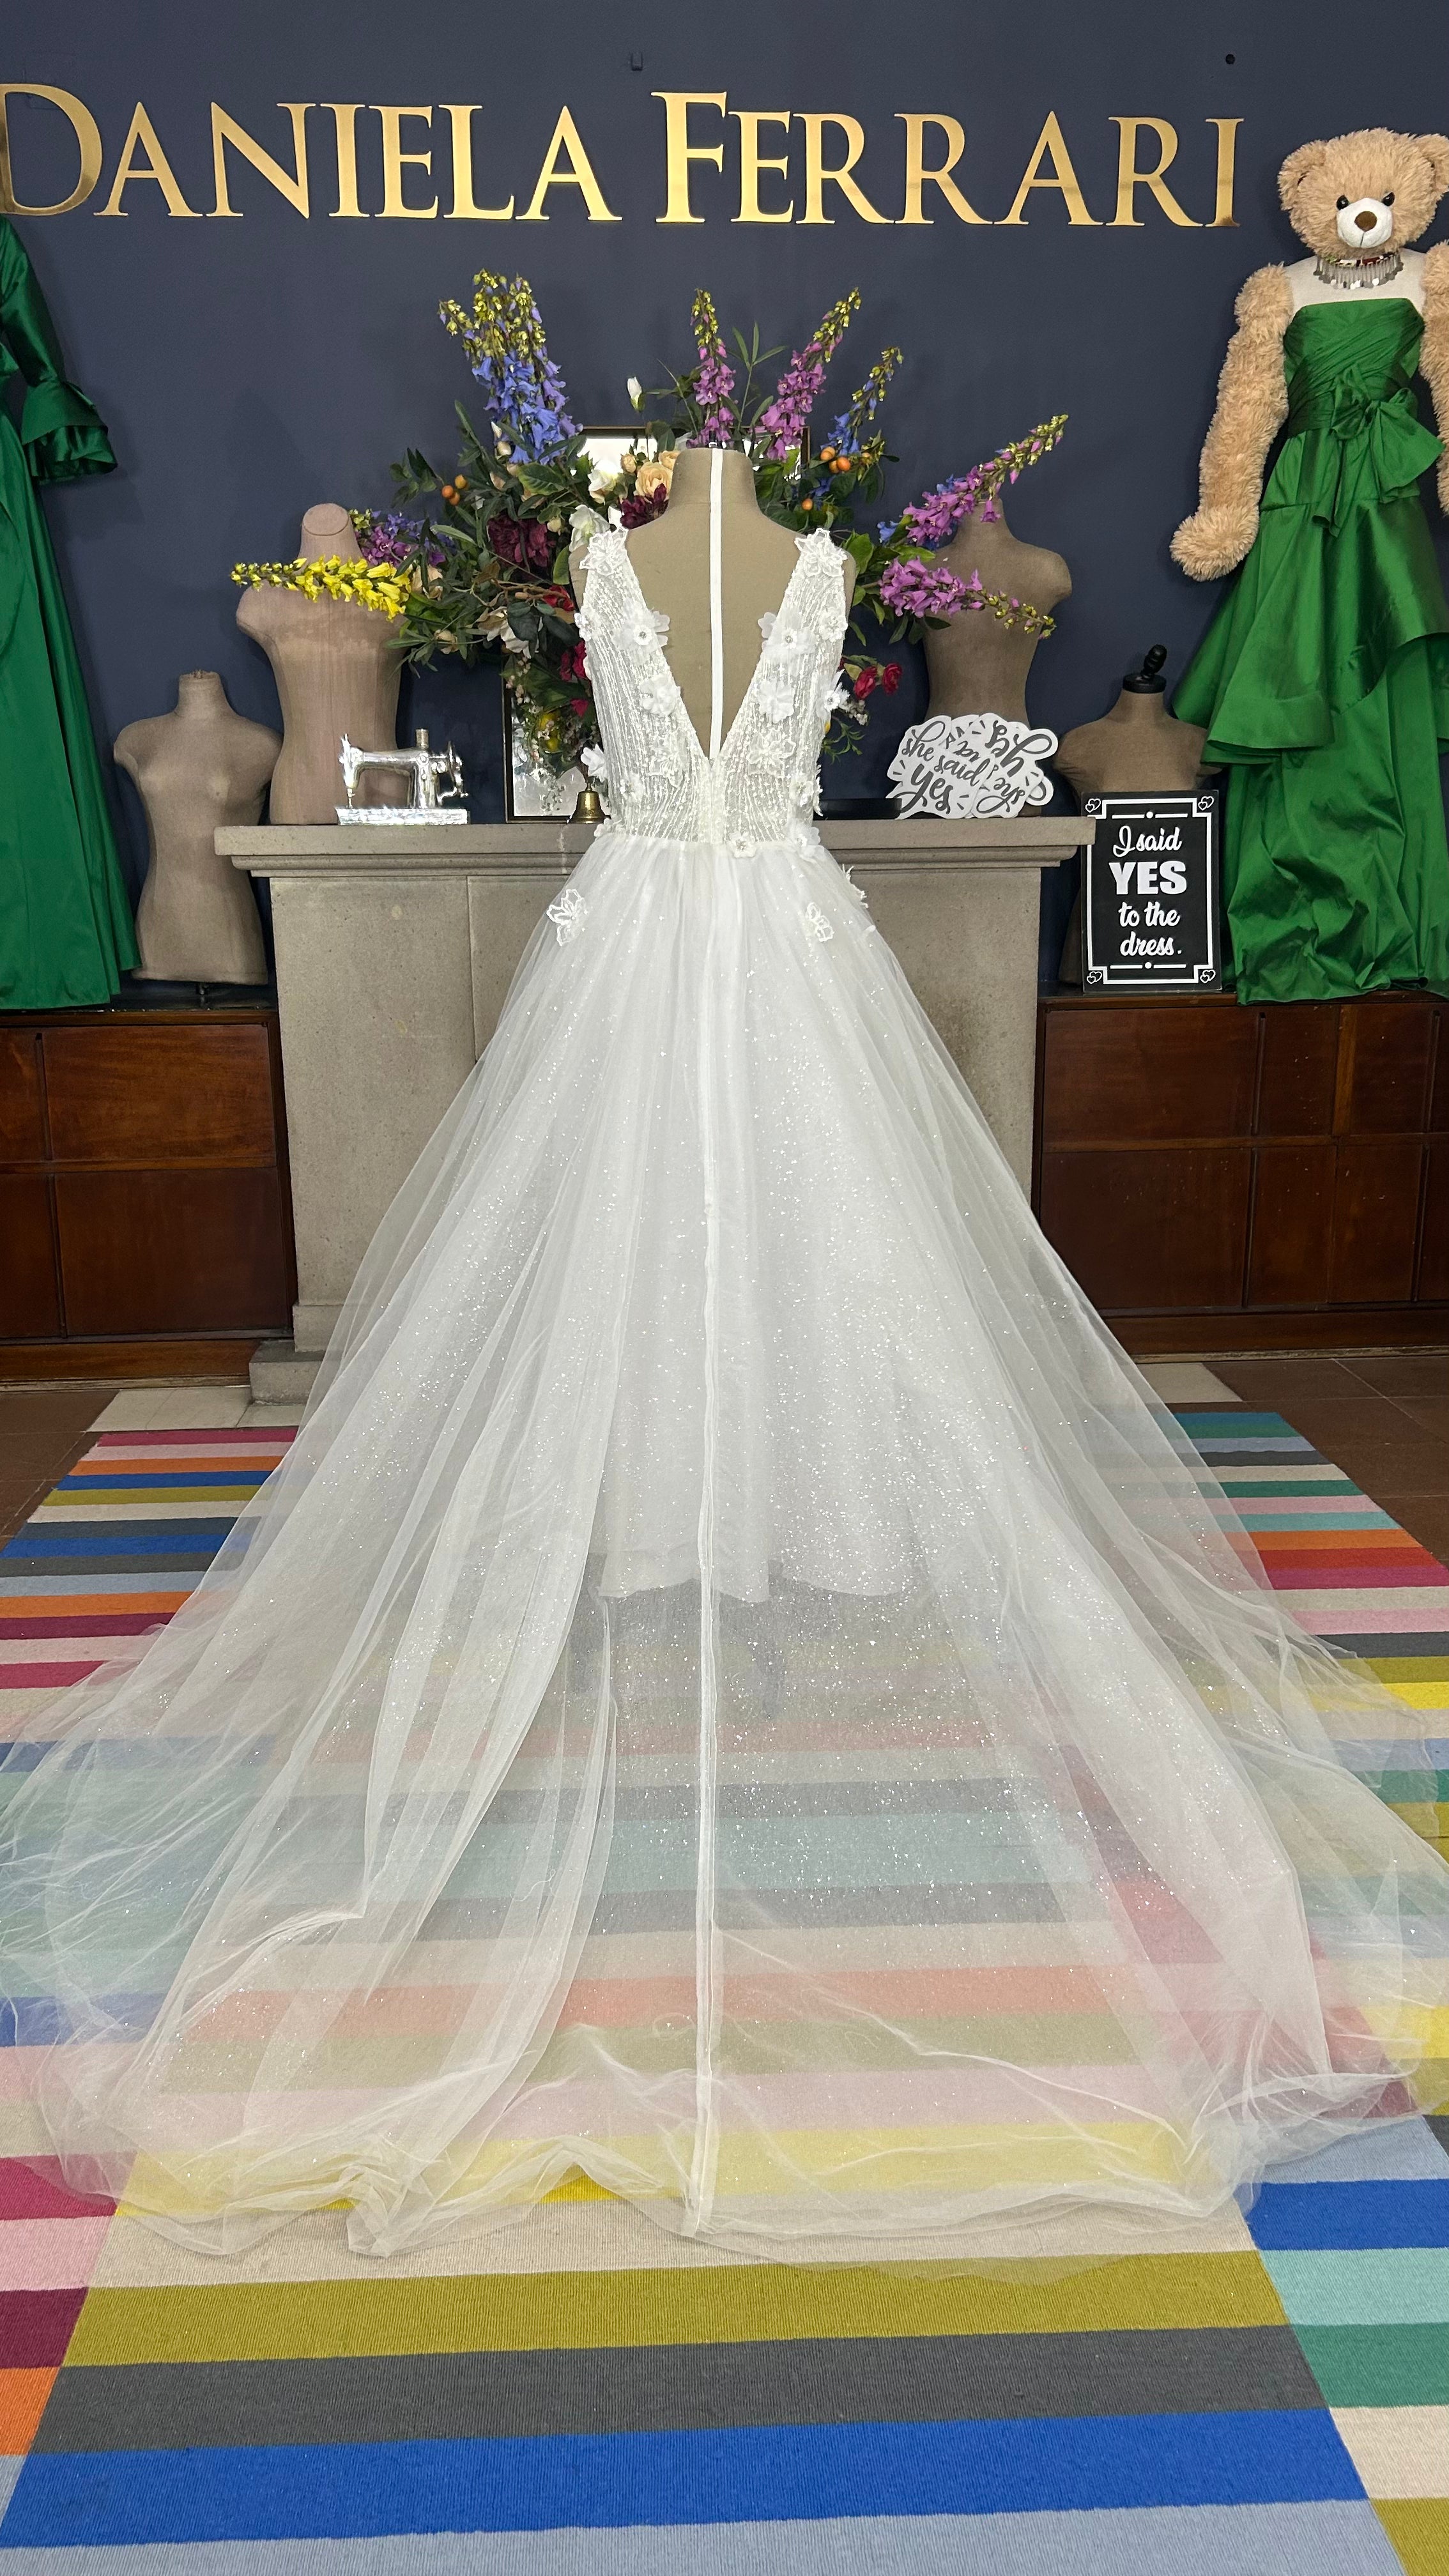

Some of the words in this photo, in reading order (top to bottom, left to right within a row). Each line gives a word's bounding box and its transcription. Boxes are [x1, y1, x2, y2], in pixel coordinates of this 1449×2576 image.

[0, 83, 623, 221] DANIELA
[650, 91, 1245, 228] FERRARI
[901, 720, 946, 762] she
[933, 755, 990, 787] said
[894, 763, 954, 815] yes
[1136, 826, 1183, 852] said
[1108, 860, 1187, 895] YES
[1118, 901, 1140, 927] to
[1144, 901, 1181, 927] the
[1119, 931, 1182, 956] dress.
